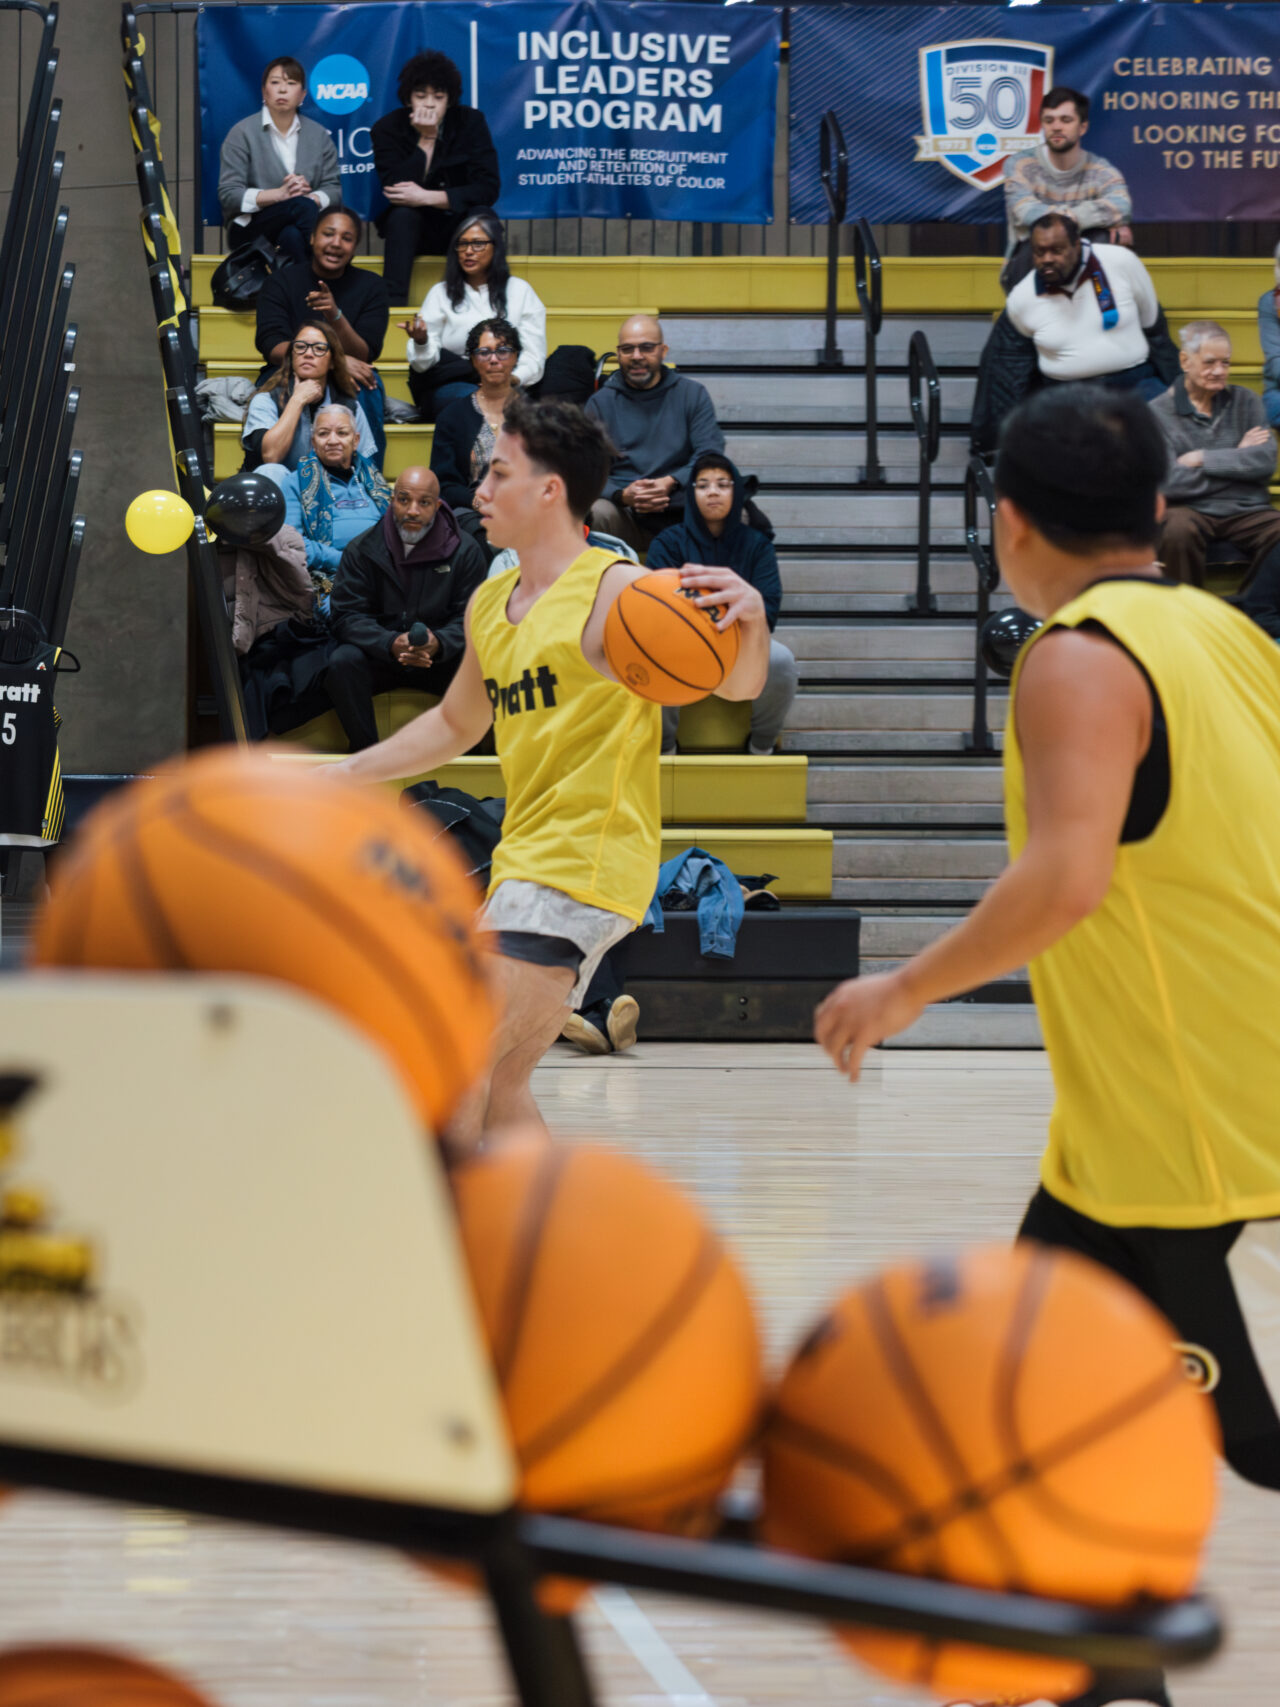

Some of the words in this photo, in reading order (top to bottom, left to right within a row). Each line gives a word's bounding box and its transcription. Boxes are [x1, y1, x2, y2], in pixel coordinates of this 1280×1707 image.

[518, 30, 731, 64] INCLUSIVE
[945, 64, 1008, 75] DIVISION
[1113, 57, 1273, 76] CELEBRATING
[316, 83, 368, 100] NCAA
[535, 65, 713, 98] LEADERS
[949, 76, 1026, 130] 50
[1103, 90, 1241, 110] HONORING
[1247, 91, 1280, 109] TH
[524, 98, 722, 133] PROGRAM
[1132, 124, 1247, 144] LOOKING
[516, 148, 597, 160] ADVANCING
[599, 149, 626, 160] THE
[629, 149, 729, 164] RECRUITMENT
[1162, 150, 1195, 169] TO
[1201, 151, 1243, 168] THE
[1251, 151, 1280, 169] FU
[557, 160, 588, 172] AND
[589, 161, 665, 174] RETENTION
[667, 163, 687, 175] OF
[518, 172, 652, 187] STUDENT-ATHLETES
[654, 175, 673, 187] OF
[676, 176, 726, 189] COLOR
[484, 665, 558, 722] Pratt
[1, 712, 17, 745] 5
